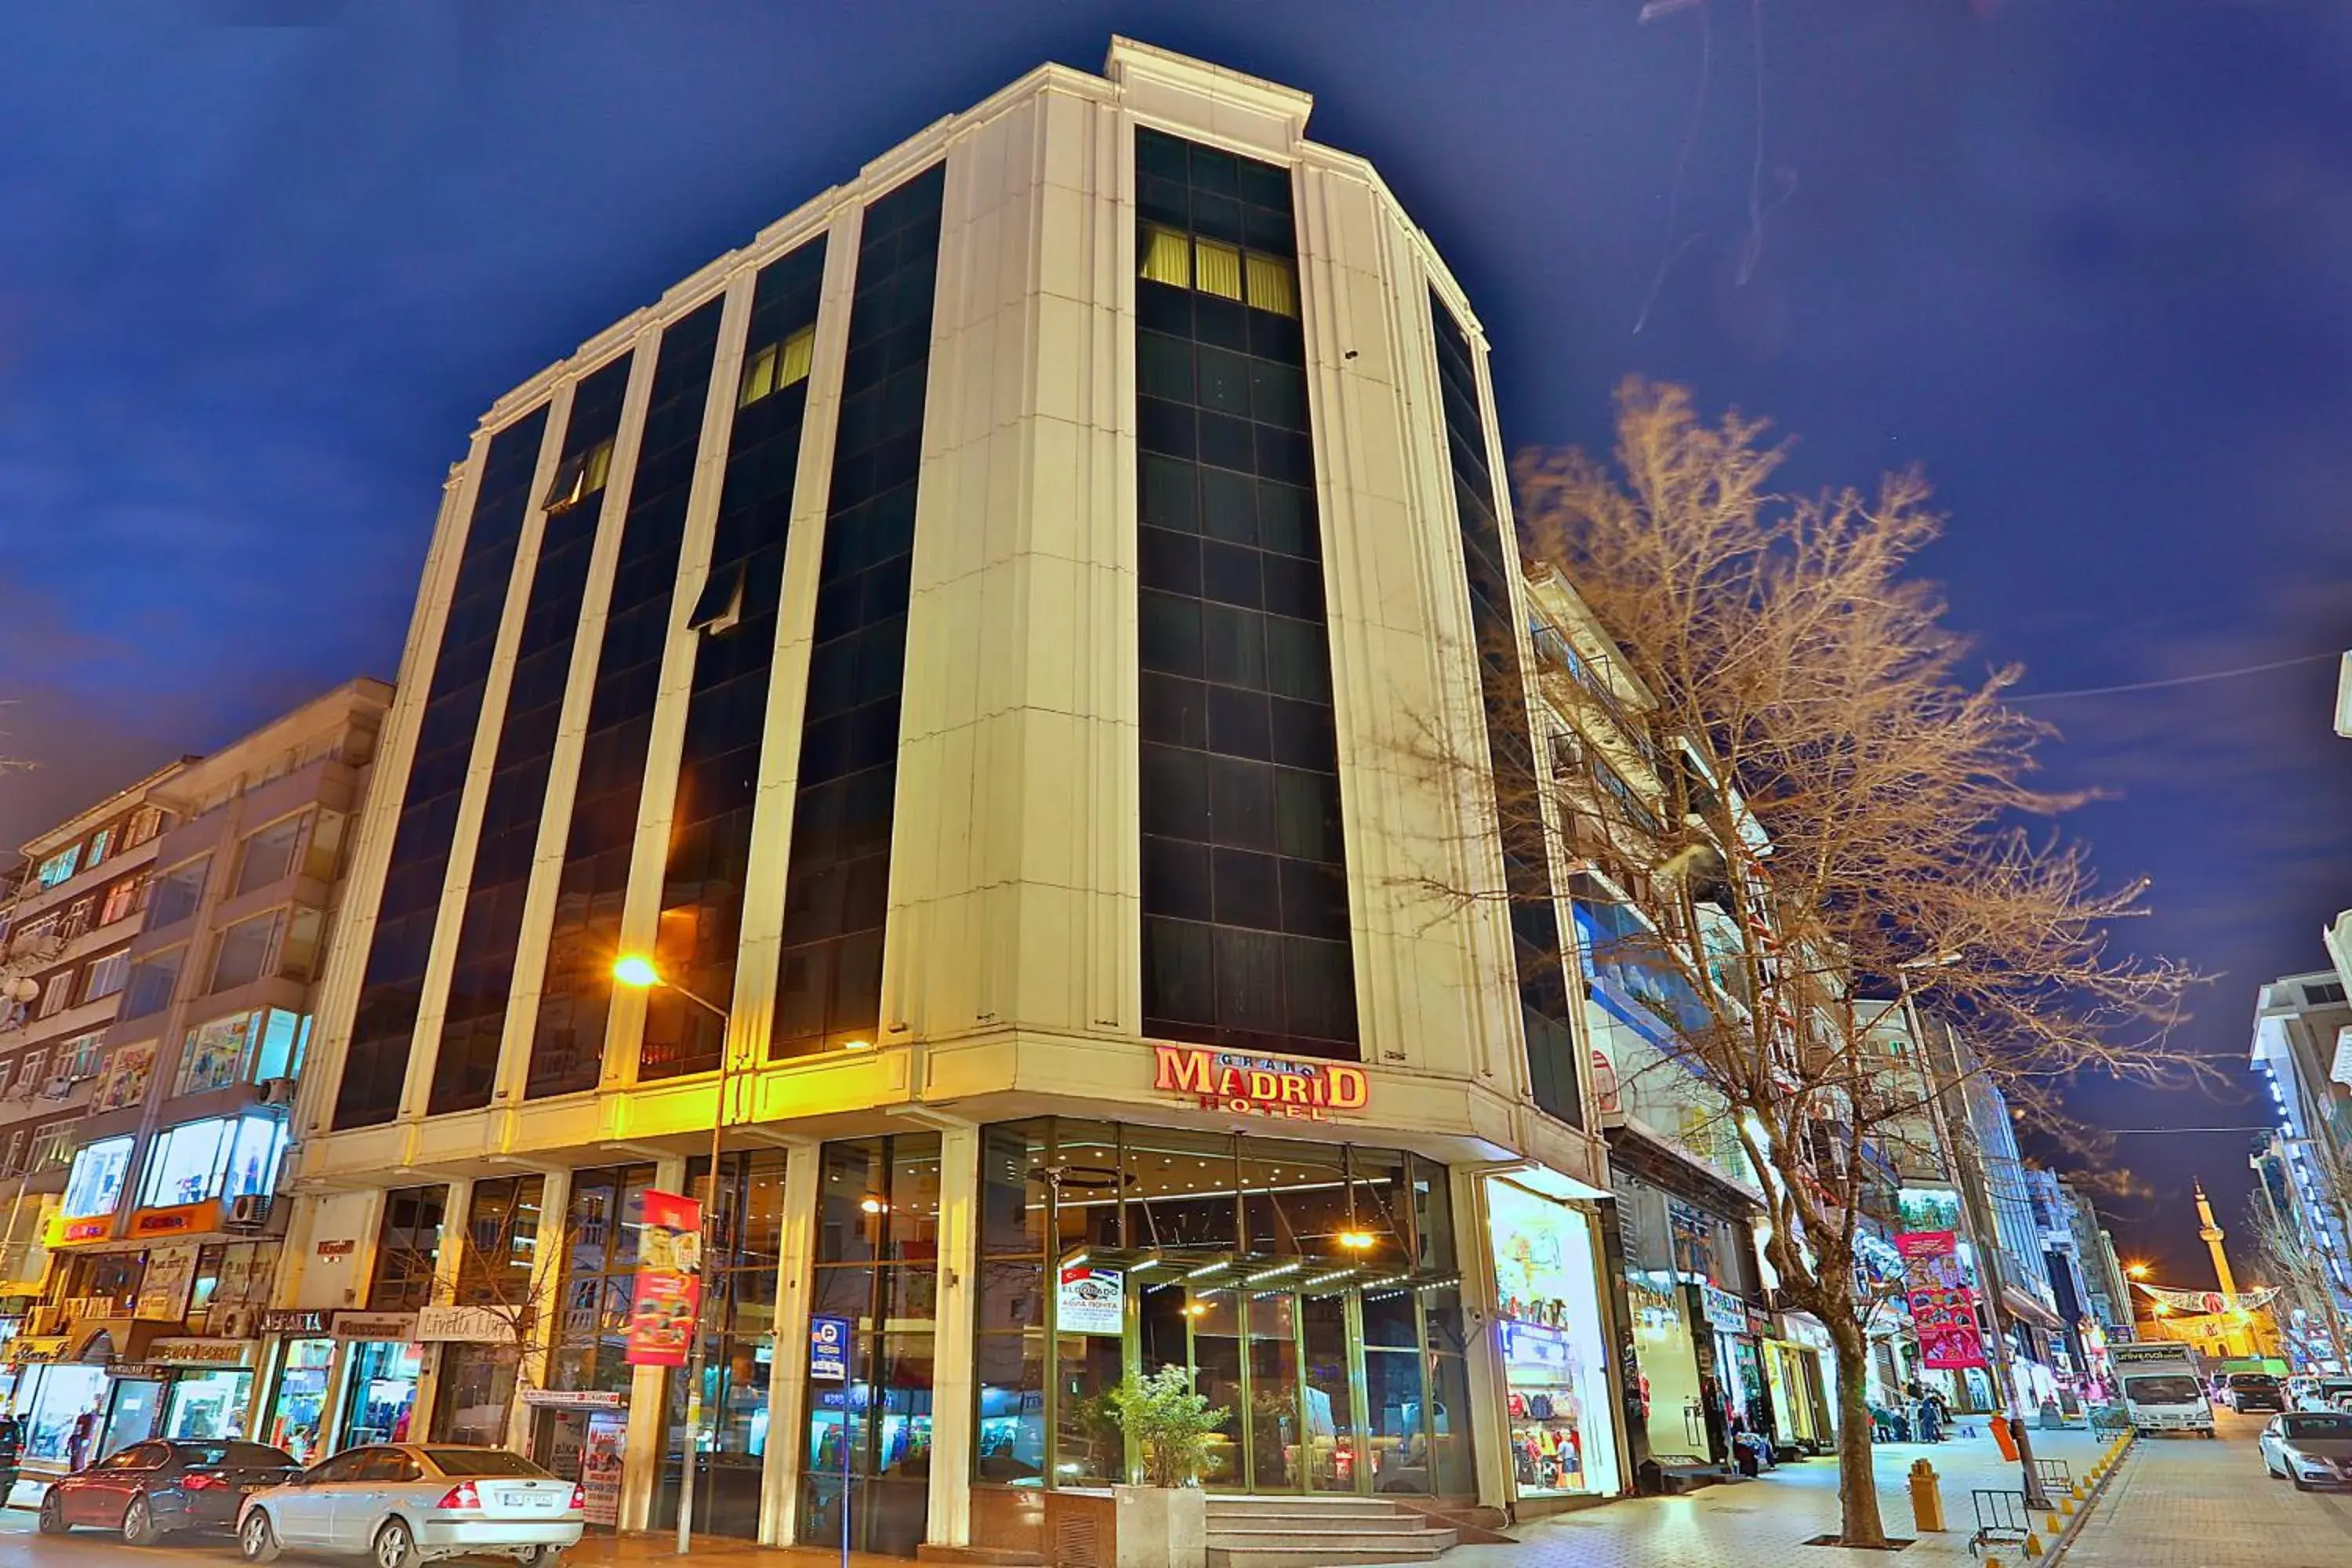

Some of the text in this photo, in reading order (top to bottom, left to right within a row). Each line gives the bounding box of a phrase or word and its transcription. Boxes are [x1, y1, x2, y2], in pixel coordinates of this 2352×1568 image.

[1154, 1046, 1369, 1109] MADRID
[1200, 1096, 1327, 1121] HOTEL
[1062, 1285, 1119, 1296] ELDORADO
